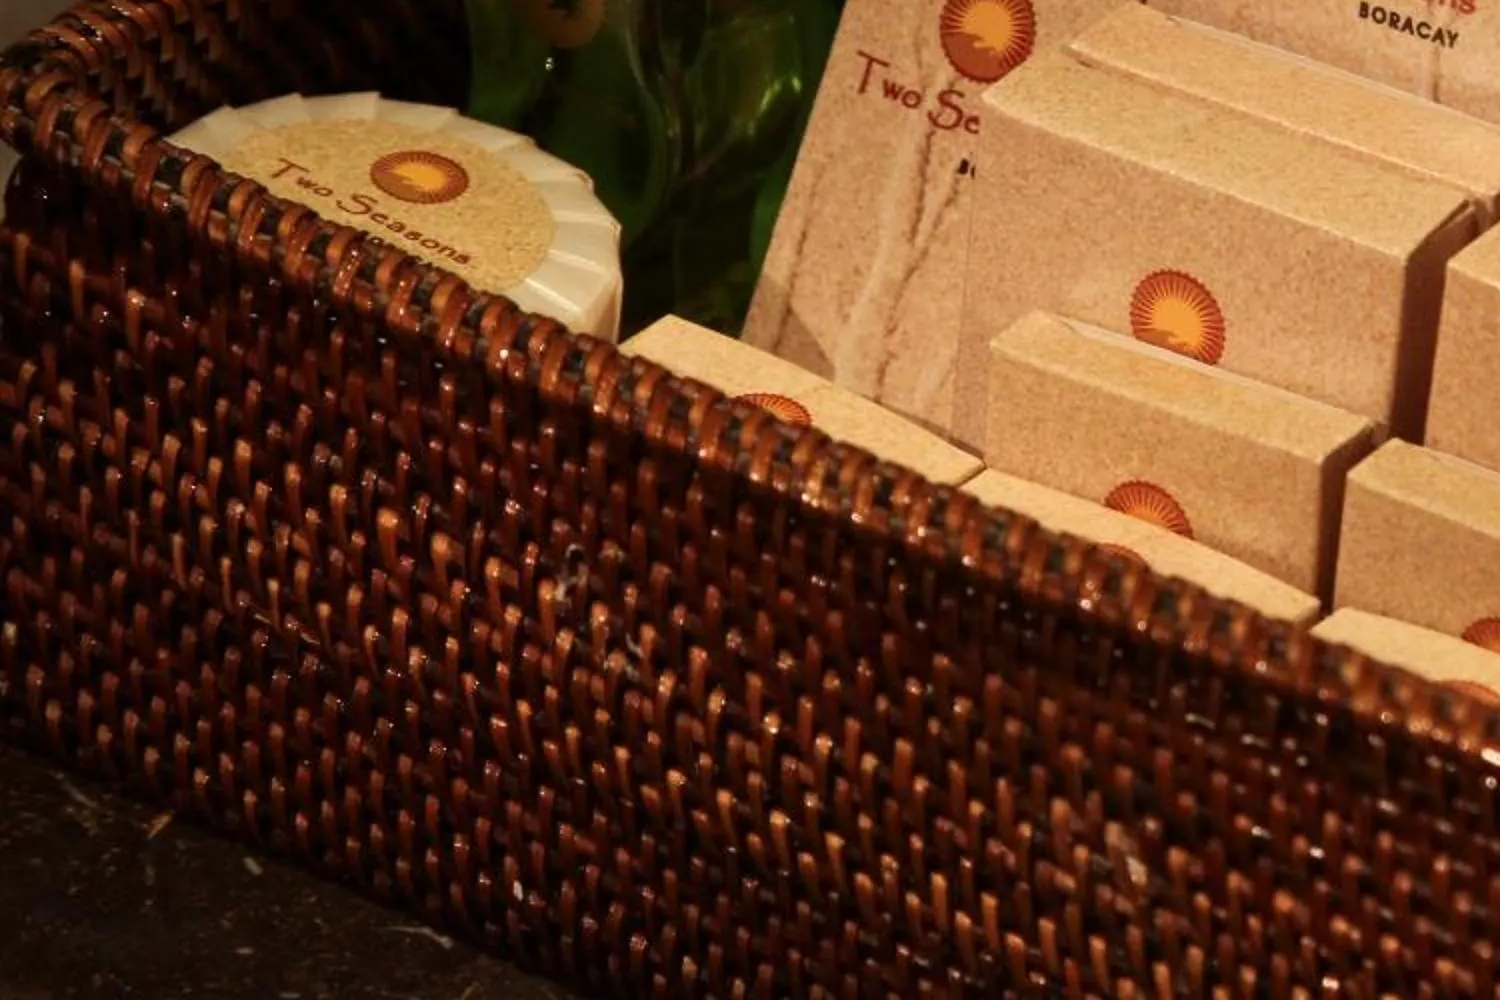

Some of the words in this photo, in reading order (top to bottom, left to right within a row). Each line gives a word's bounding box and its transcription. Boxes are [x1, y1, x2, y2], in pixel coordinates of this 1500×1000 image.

[1358, 1, 1460, 49] BORACAY
[857, 50, 923, 110] Two
[271, 157, 334, 198] Two
[335, 192, 472, 265] Seasons
